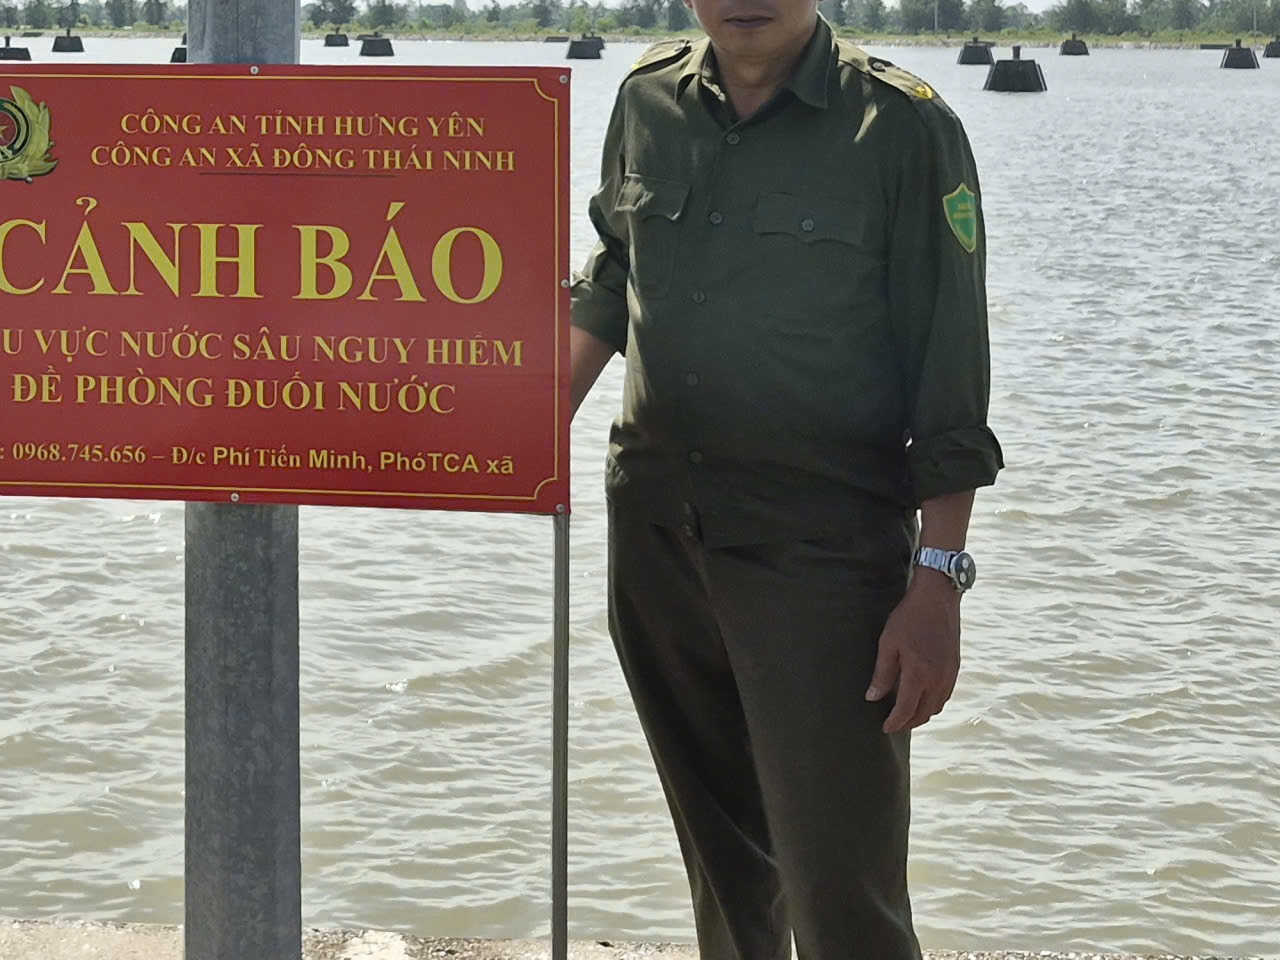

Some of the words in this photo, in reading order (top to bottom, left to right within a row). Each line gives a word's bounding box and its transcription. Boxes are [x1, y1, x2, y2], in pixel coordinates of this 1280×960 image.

[120, 108, 201, 135] CÔNG
[207, 115, 246, 135] AN
[254, 109, 324, 136] TỈNH
[335, 113, 418, 137] HƯNG
[426, 111, 485, 138] YÊN
[91, 140, 171, 167] CÔNG
[179, 147, 216, 167] AN
[225, 142, 264, 168] XÃ
[272, 142, 354, 169] ĐÔNG
[362, 144, 433, 170] THÁI
[442, 150, 515, 172] NINH
[291, 201, 503, 305] BÁO
[33, 326, 109, 363] VỰC
[120, 324, 222, 360] NƯỚC
[232, 326, 302, 361] SÂU
[312, 335, 417, 364] NGUY
[426, 331, 524, 367] HIỂM
[11, 365, 63, 403] ĐỀ
[74, 368, 215, 407] PHÒNG
[226, 371, 325, 410] ĐUỐI
[337, 374, 456, 414] NƯỚC
[12, 442, 146, 463] 0968.745.656
[171, 446, 206, 465] Đ/c
[213, 446, 250, 466] Phí
[254, 444, 302, 467] Tiến
[309, 449, 372, 472] Minh,
[487, 455, 513, 474] xã
